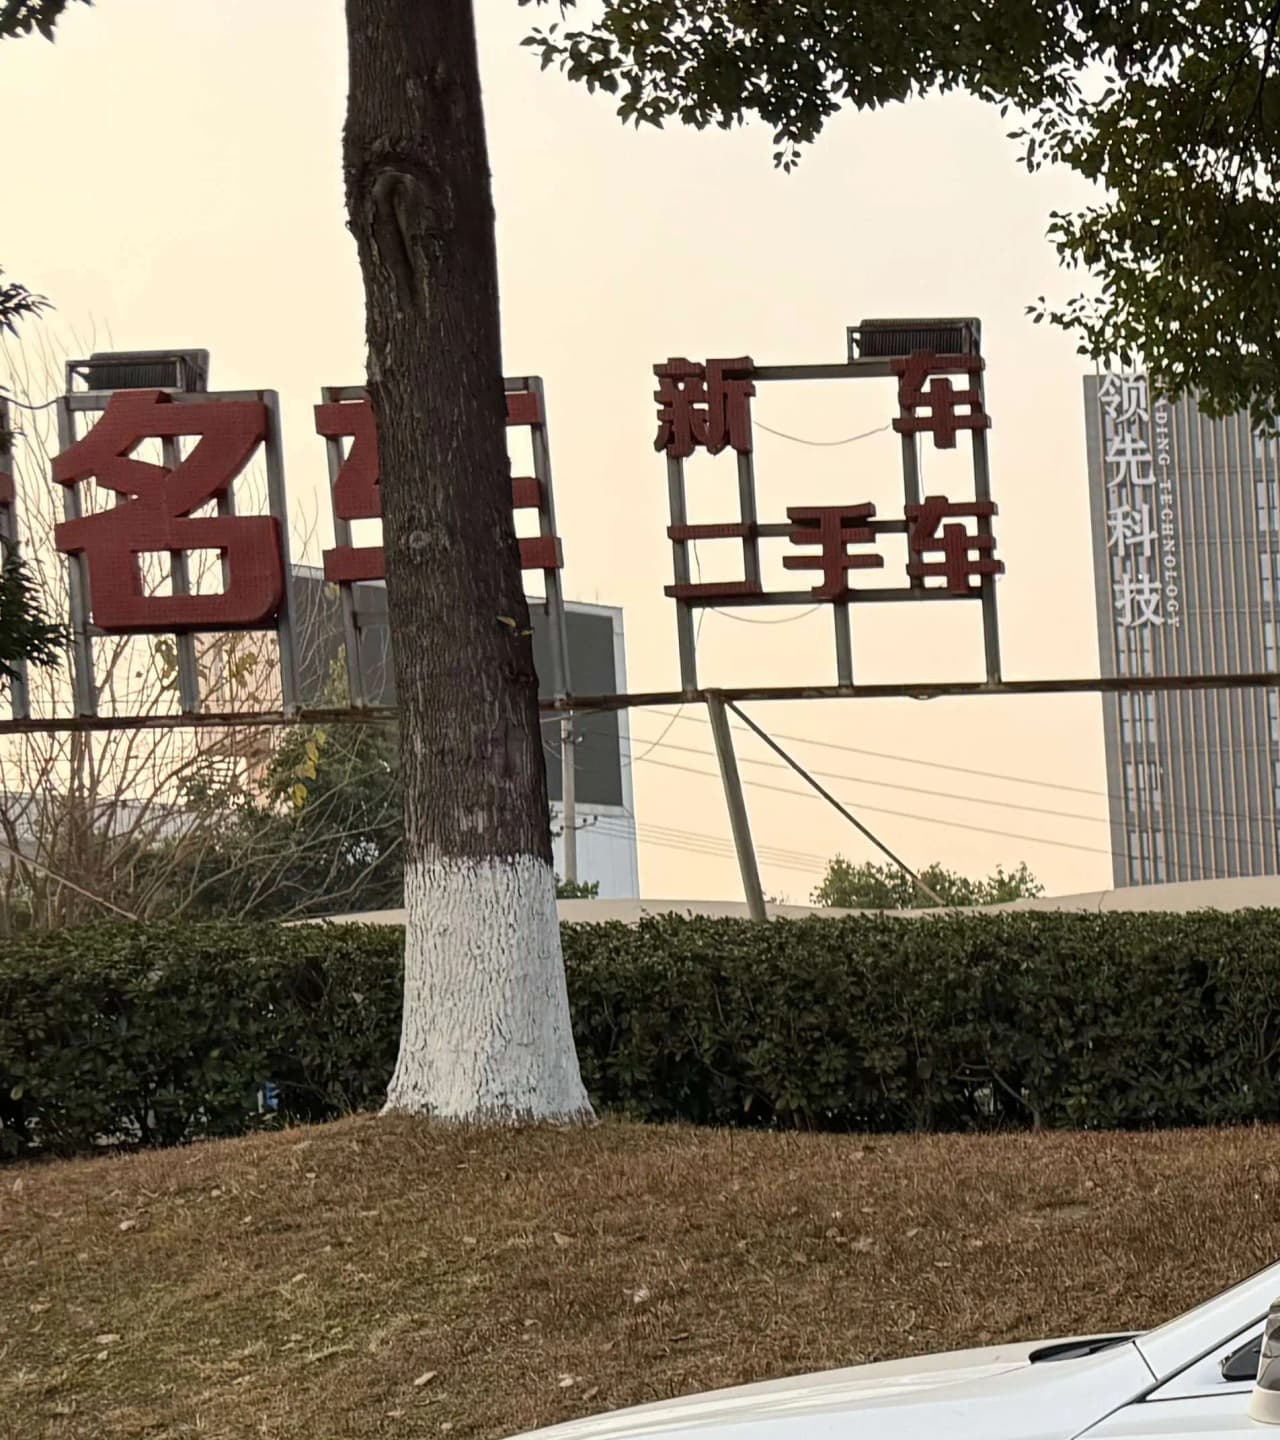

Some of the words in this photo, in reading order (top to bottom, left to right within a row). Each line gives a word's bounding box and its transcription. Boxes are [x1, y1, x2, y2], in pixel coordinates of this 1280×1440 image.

[653, 348, 991, 458] 新车
[663, 495, 1005, 599] 二手车
[1097, 368, 1165, 628] 领先科技
[1159, 480, 1180, 627] TECHNOLOGY
